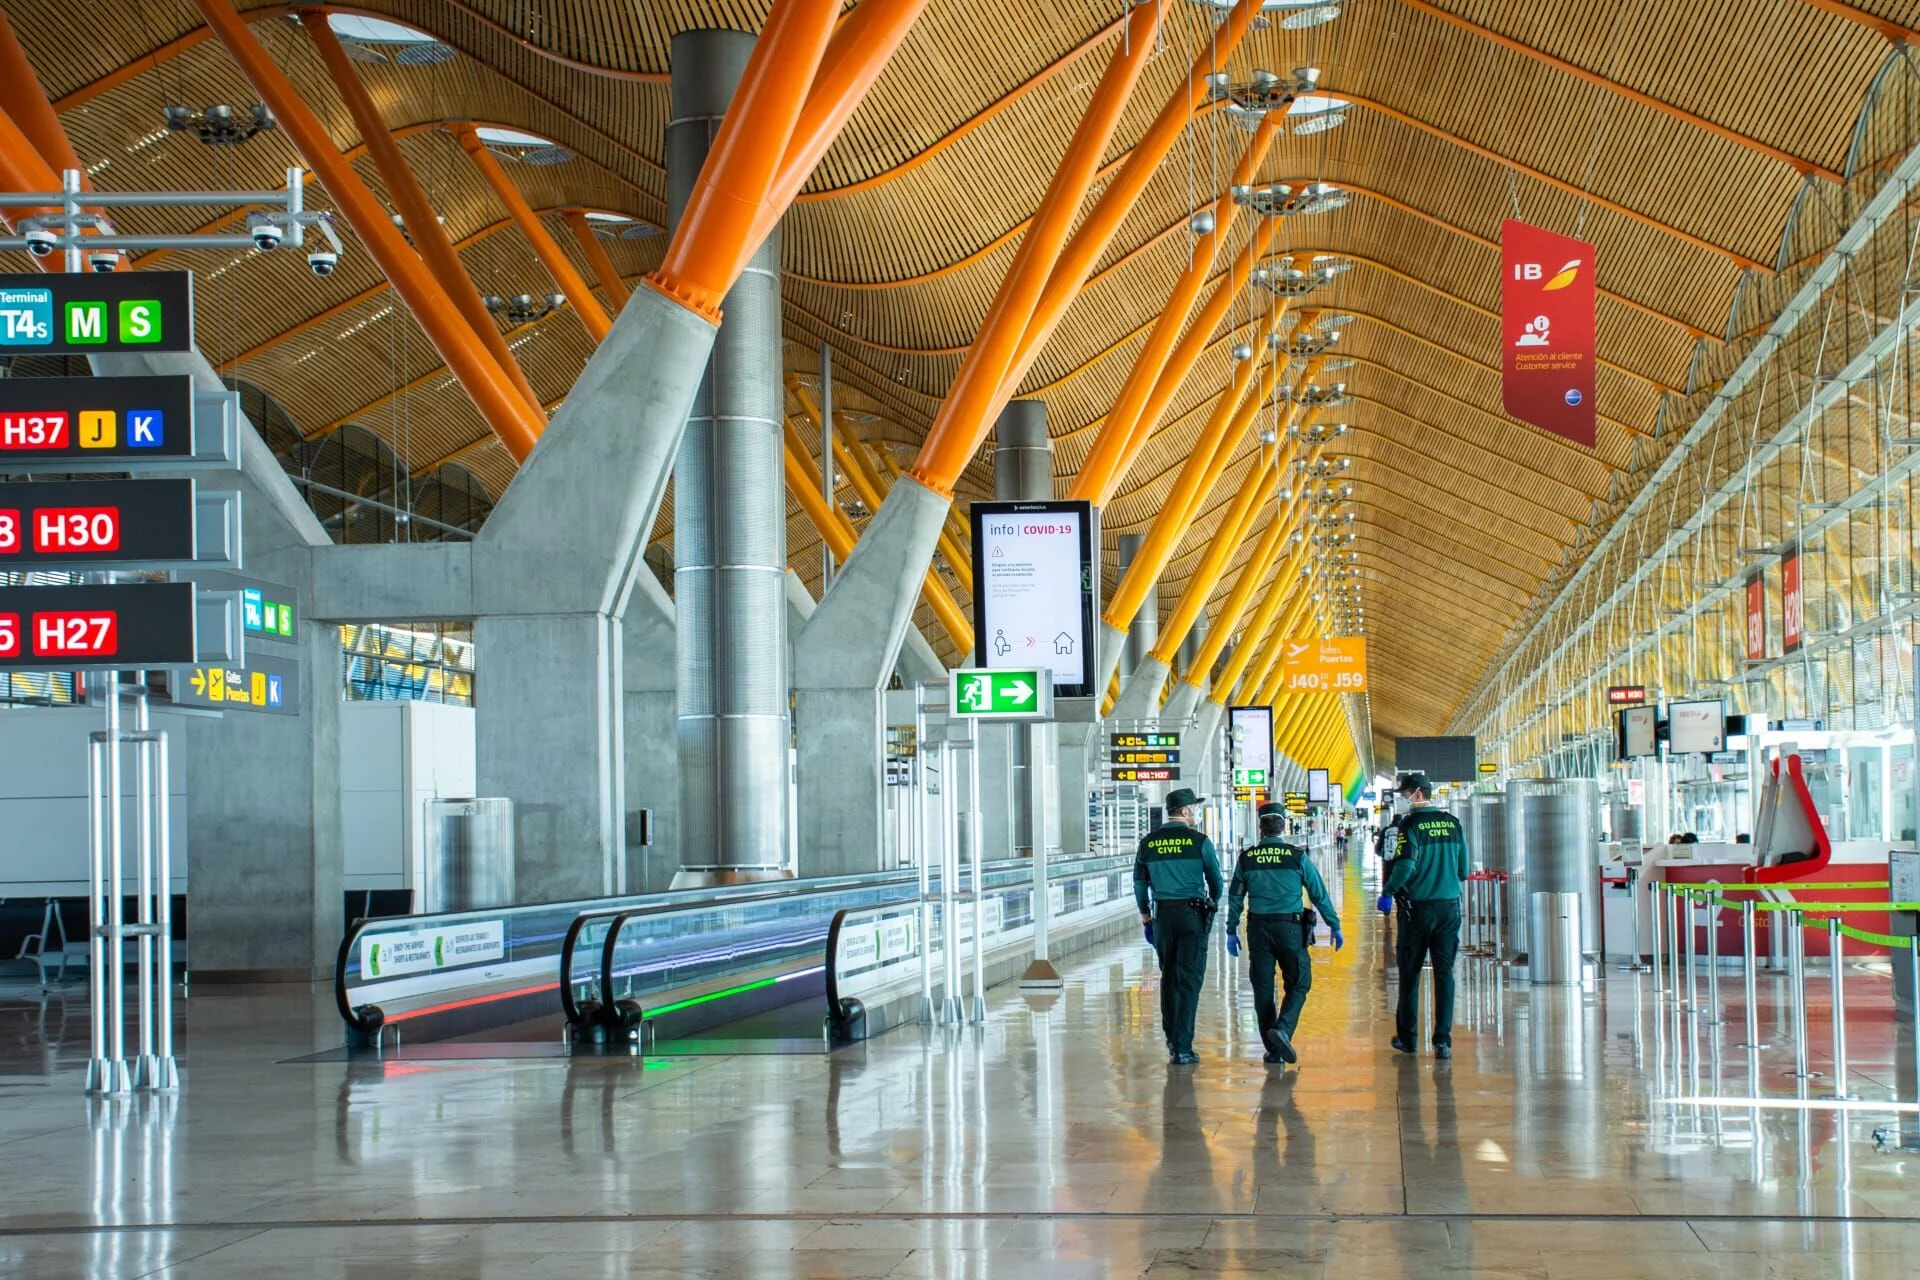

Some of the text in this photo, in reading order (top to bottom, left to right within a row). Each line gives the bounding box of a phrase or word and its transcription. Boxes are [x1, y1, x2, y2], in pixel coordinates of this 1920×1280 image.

[1514, 263, 1543, 281] IB
[0, 291, 47, 302] Terminal
[71, 307, 101, 338] M
[130, 305, 151, 337] S
[1516, 352, 1583, 362] Atención al cliente
[1515, 361, 1577, 371] Customer service
[4, 416, 155, 444] H37 J K
[40, 513, 114, 547] H30
[990, 523, 1072, 536] info COVID-19
[39, 617, 111, 650] H27
[1319, 655, 1353, 664] Puertas
[1287, 673, 1319, 689] J40
[1332, 672, 1363, 688] J59
[269, 679, 279, 703] K
[1418, 821, 1455, 830] GUARDIA
[1429, 829, 1450, 837] CIVIL
[1148, 838, 1193, 848] GUARDIA
[1157, 846, 1182, 854] CIVIL
[1247, 847, 1292, 857] GUARDIA
[1256, 855, 1282, 864] CIVIL
